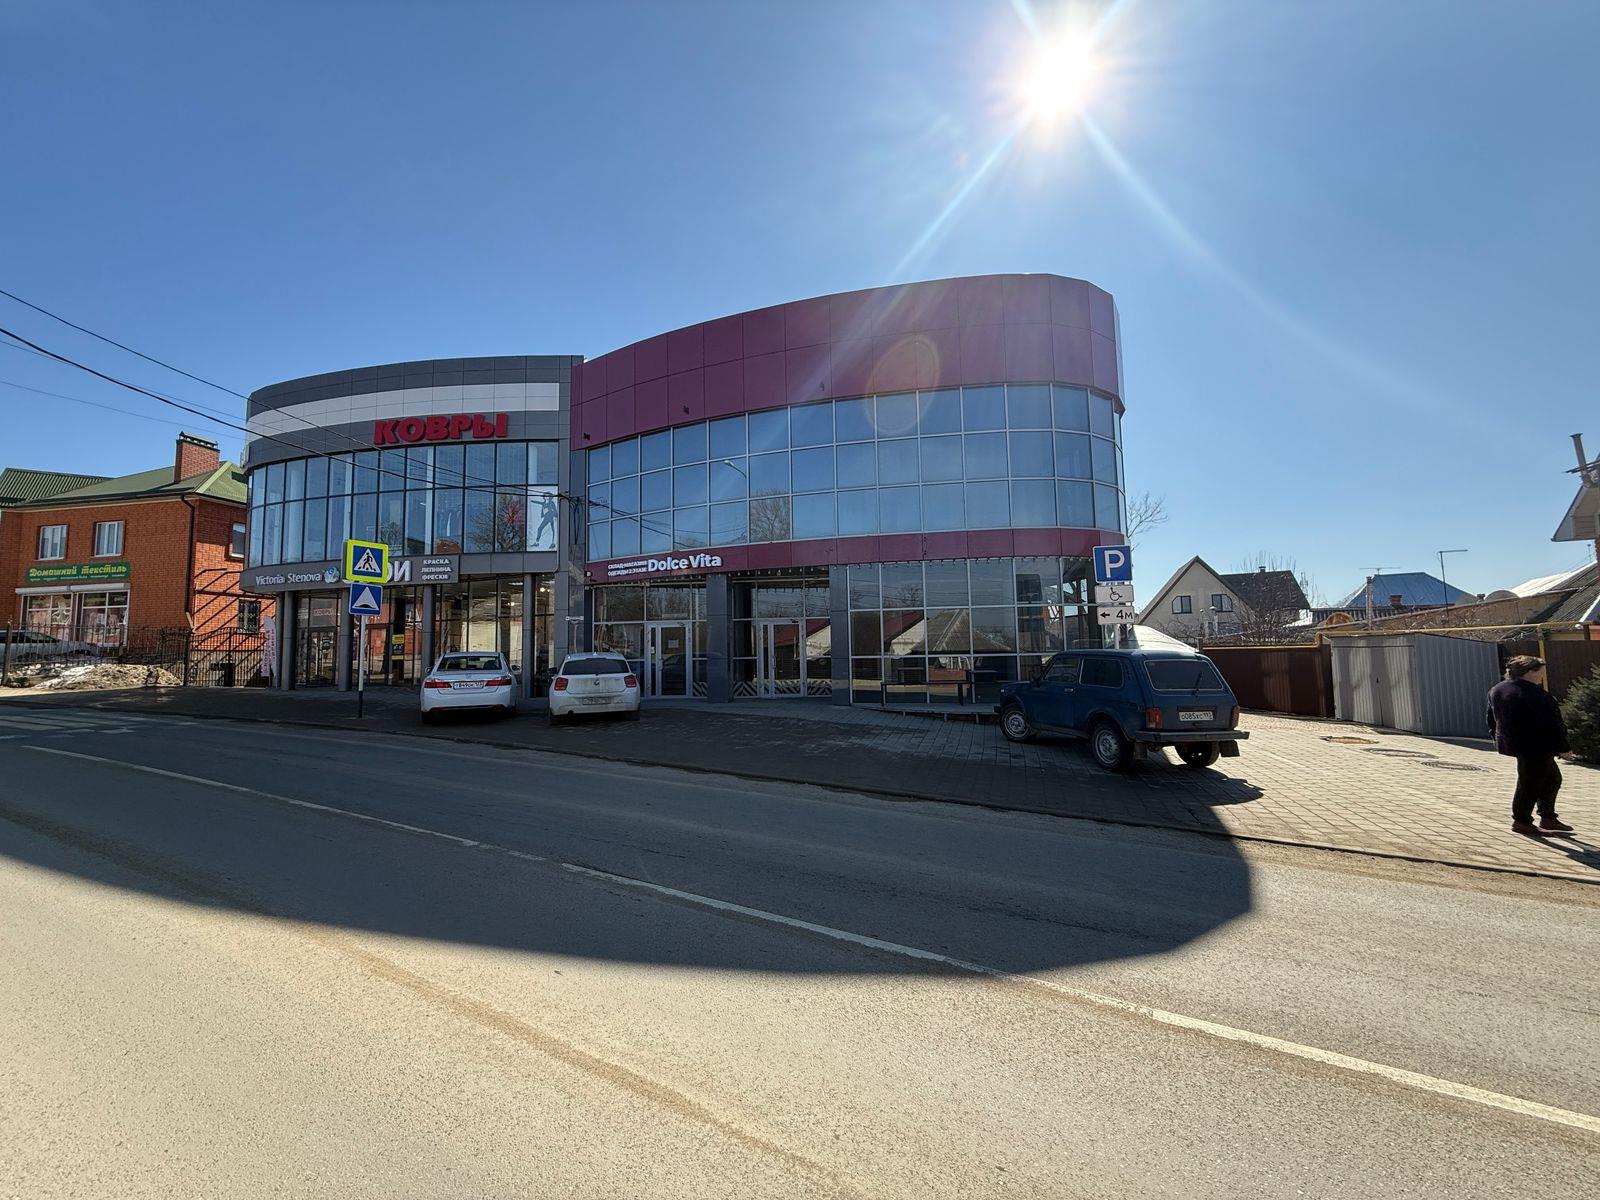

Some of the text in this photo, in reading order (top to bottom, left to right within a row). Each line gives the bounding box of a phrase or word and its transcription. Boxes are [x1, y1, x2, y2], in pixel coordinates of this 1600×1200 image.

[373, 413, 508, 445] КОВРЫ
[1104, 550, 1125, 578] P
[256, 572, 321, 585] Victoria Stenova
